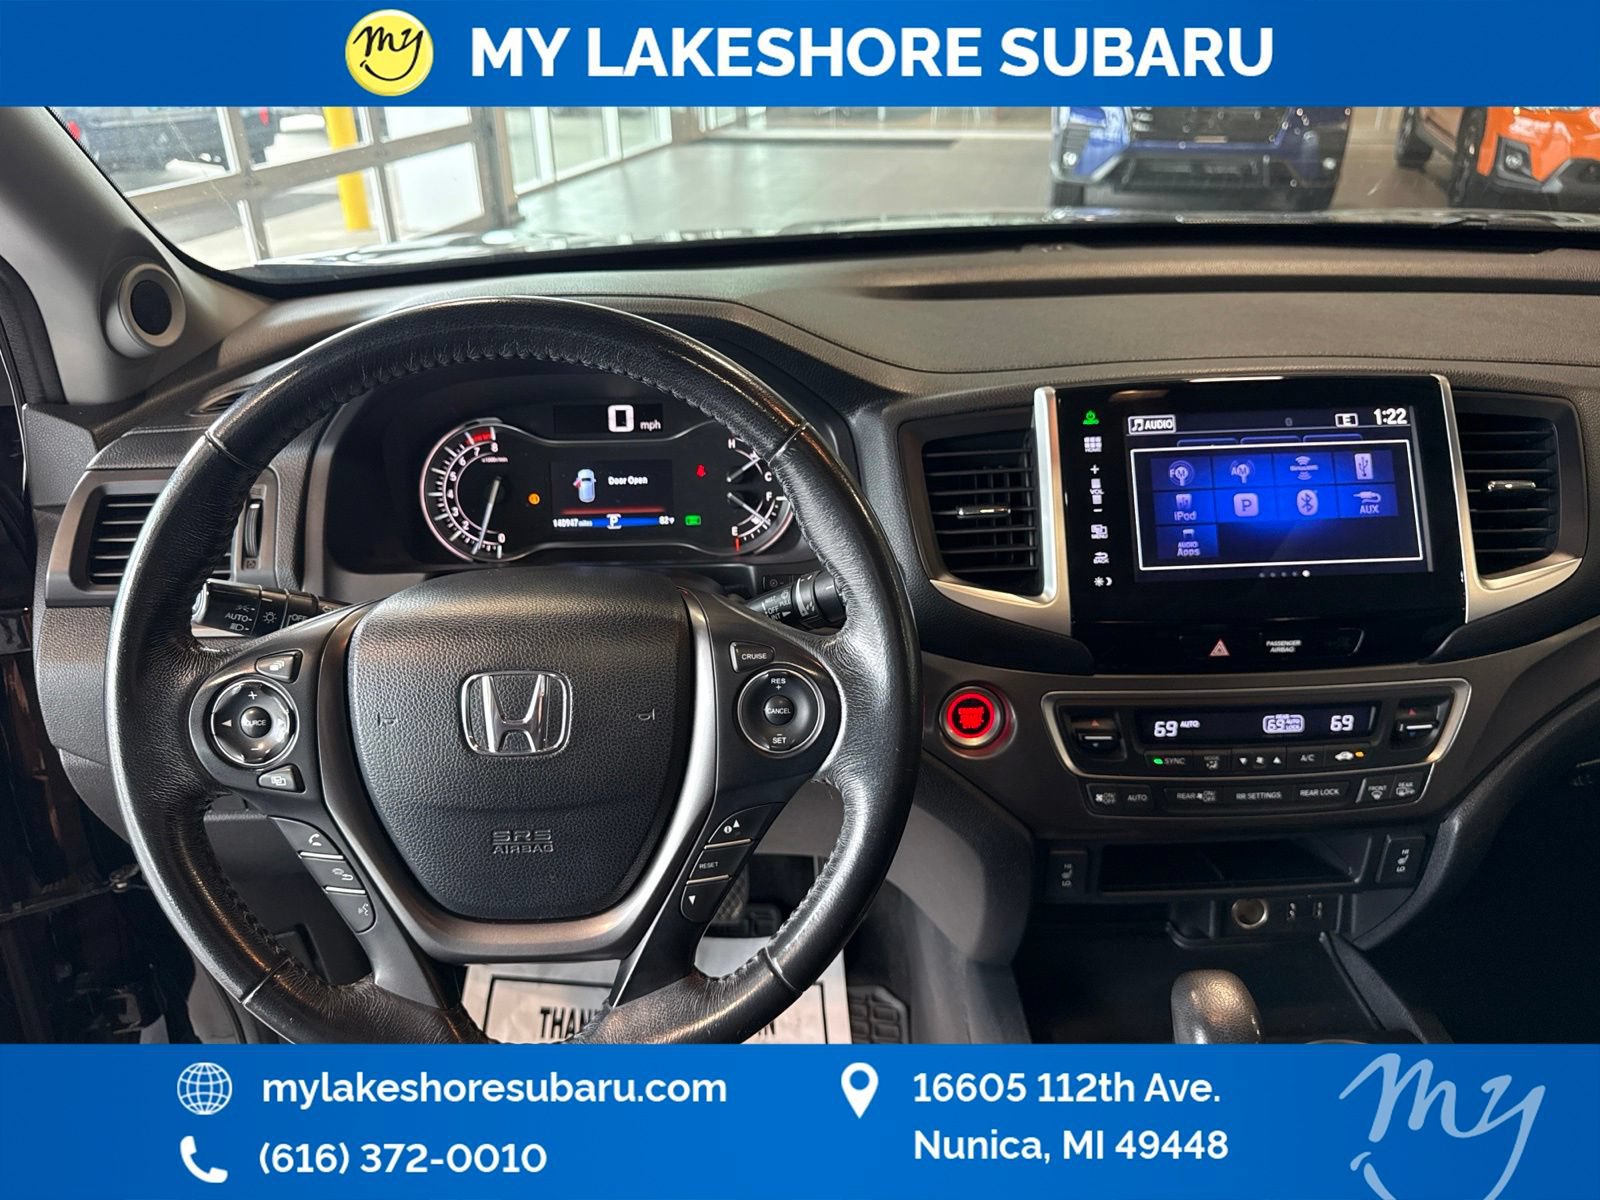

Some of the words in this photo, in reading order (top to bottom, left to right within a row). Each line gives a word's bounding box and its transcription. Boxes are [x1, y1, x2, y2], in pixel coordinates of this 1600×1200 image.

[608, 404, 635, 432] 0
[640, 419, 662, 431] mph
[1374, 408, 1408, 425] 1:22
[1144, 418, 1174, 430] AUDIO
[490, 442, 499, 453] 8
[728, 438, 736, 449] H
[473, 446, 481, 457] 7
[459, 456, 467, 466] 6
[449, 472, 457, 482] 5
[607, 476, 627, 486] Door
[627, 475, 649, 486] Open
[764, 471, 772, 482] C
[446, 489, 454, 499] 4
[765, 491, 773, 502] F
[1089, 488, 1105, 496] VOL
[452, 506, 460, 517] 3
[1359, 504, 1380, 515] AUX
[1174, 510, 1197, 521] iPod
[462, 520, 470, 531] 2
[731, 525, 739, 537] E
[498, 533, 506, 544] 0
[1176, 548, 1201, 557] Apps
[767, 605, 779, 615] OFF
[224, 612, 249, 622] AUTO
[1153, 720, 1178, 737] 69
[1180, 719, 1200, 728] AUTO
[1267, 719, 1285, 731] 69
[1330, 715, 1354, 732] 69
[772, 736, 787, 744] SET
[1164, 757, 1186, 765] SYNC
[1300, 753, 1315, 762] A/C
[1300, 789, 1318, 797] REAR
[1320, 788, 1340, 796] LOCK
[1368, 784, 1387, 792] FRONT
[1247, 791, 1282, 799] SETTINGS
[493, 829, 551, 841] SRS
[493, 844, 554, 855] AIRBAG
[699, 861, 719, 869] RESET
[540, 1007, 597, 1039] THAN
